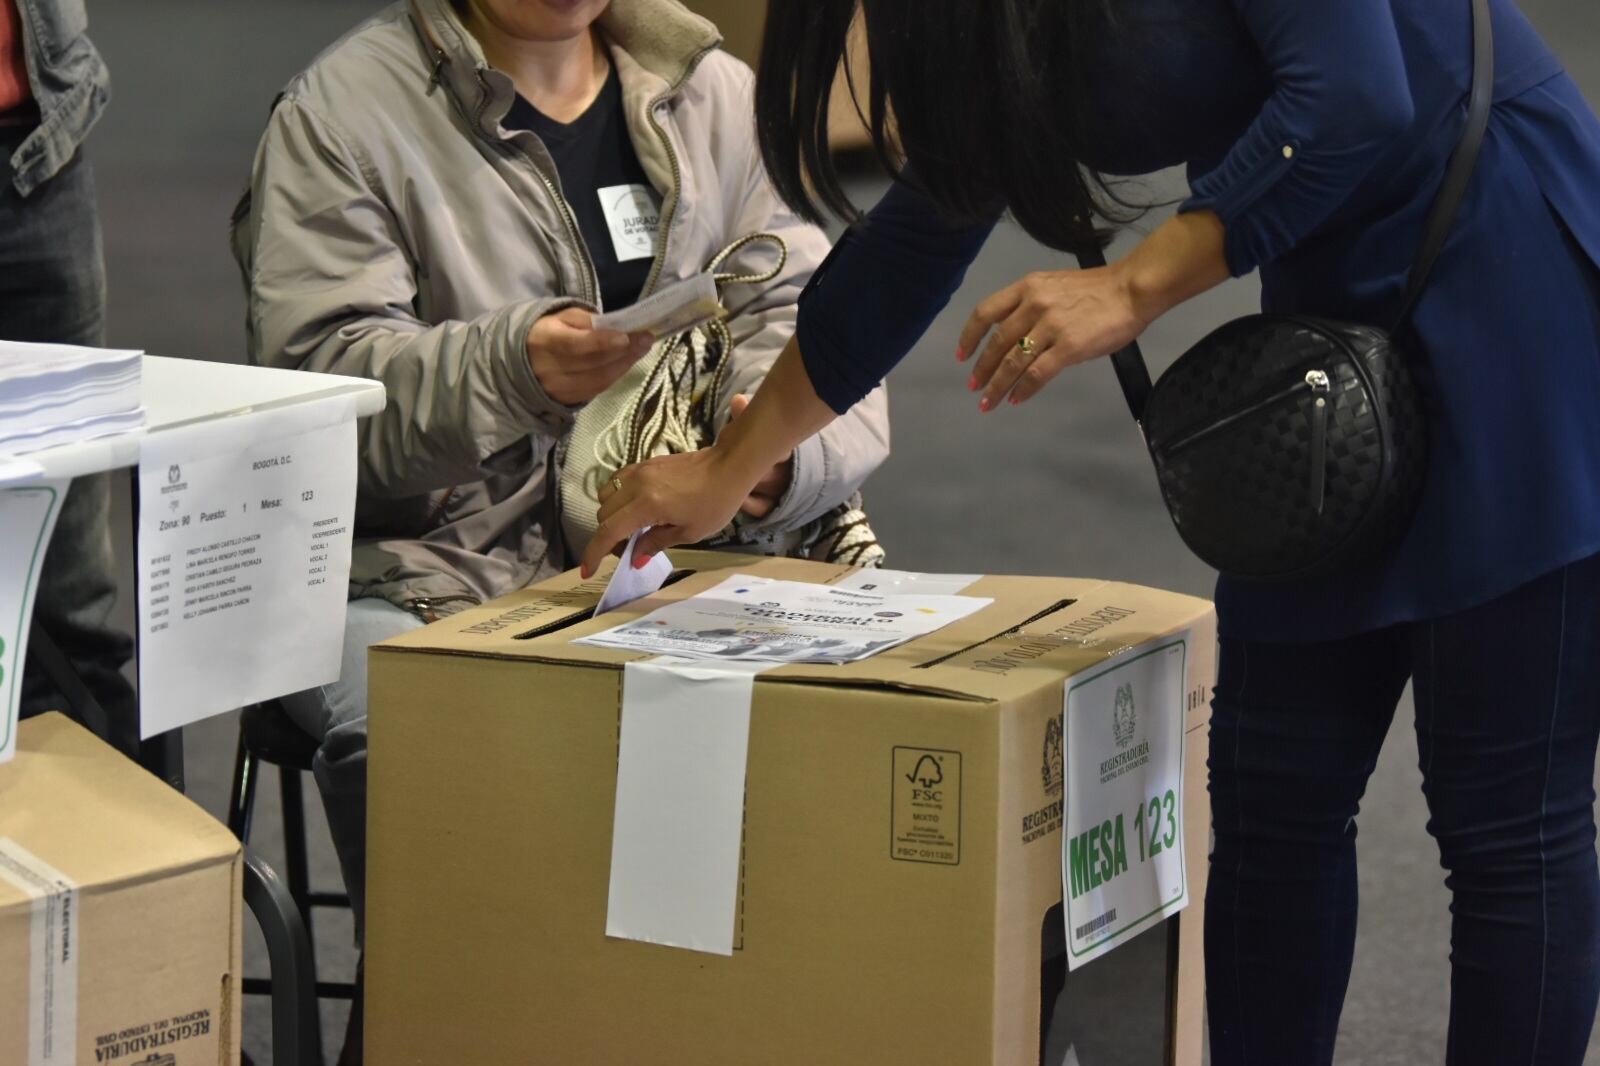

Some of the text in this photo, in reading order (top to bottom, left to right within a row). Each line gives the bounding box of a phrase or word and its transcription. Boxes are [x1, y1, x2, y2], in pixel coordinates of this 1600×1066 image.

[623, 216, 659, 228] JURAD
[159, 519, 180, 532] Zona:
[181, 514, 191, 526] 90
[200, 508, 227, 523] Puesto:
[261, 498, 283, 510] Mesa:
[301, 490, 314, 502] 123
[1100, 738, 1150, 776] REGISTRADURÍA
[912, 788, 943, 802] FSC
[912, 813, 940, 823] MIXTO
[1070, 789, 1177, 900] MESA 123
[62, 897, 71, 964] ELECTORAL
[153, 1018, 169, 1031] DEL
[172, 1008, 211, 1025] NACIONAL
